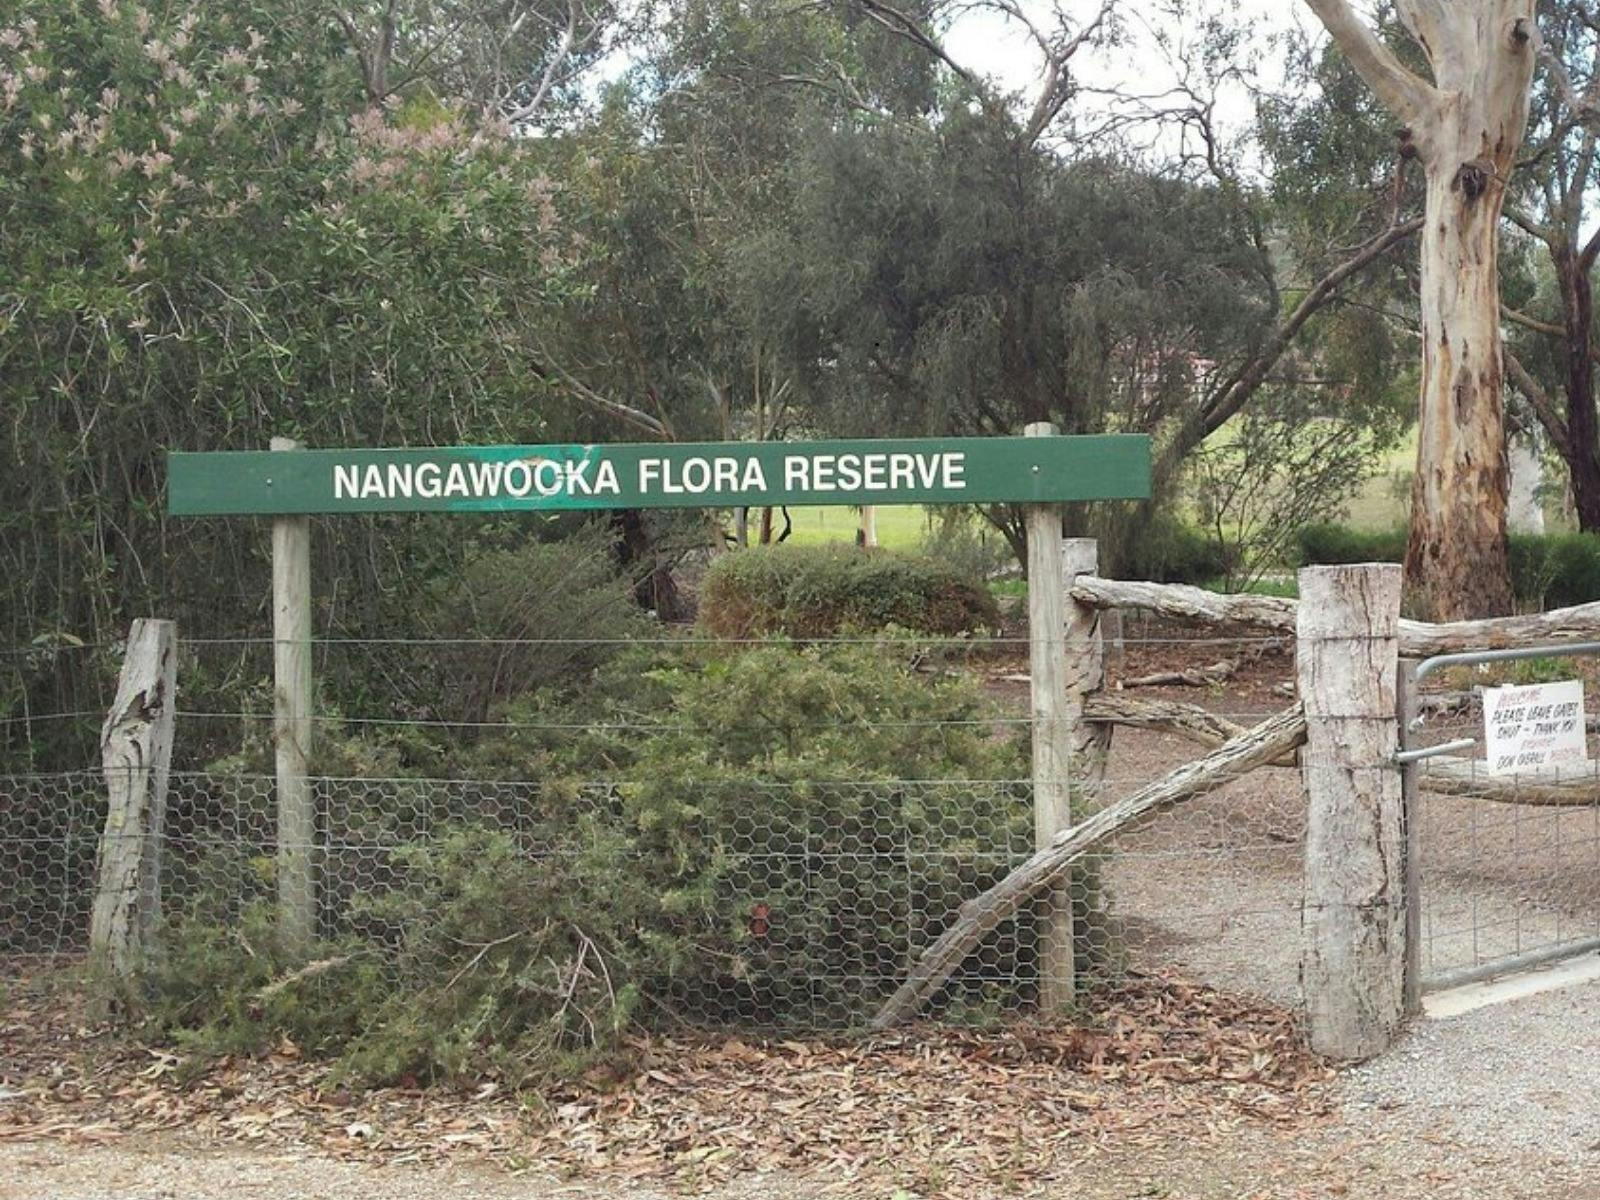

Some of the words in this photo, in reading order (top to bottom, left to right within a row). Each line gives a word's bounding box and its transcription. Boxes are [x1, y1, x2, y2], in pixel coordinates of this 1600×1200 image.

[333, 459, 621, 499] NANGAWOOKA
[638, 457, 767, 493] FLORA
[784, 453, 966, 491] RESERVE
[1493, 707, 1526, 723] PLEASE
[1527, 704, 1553, 721] LEAVE
[1553, 702, 1578, 719] GATES
[1534, 722, 1559, 735] THANK
